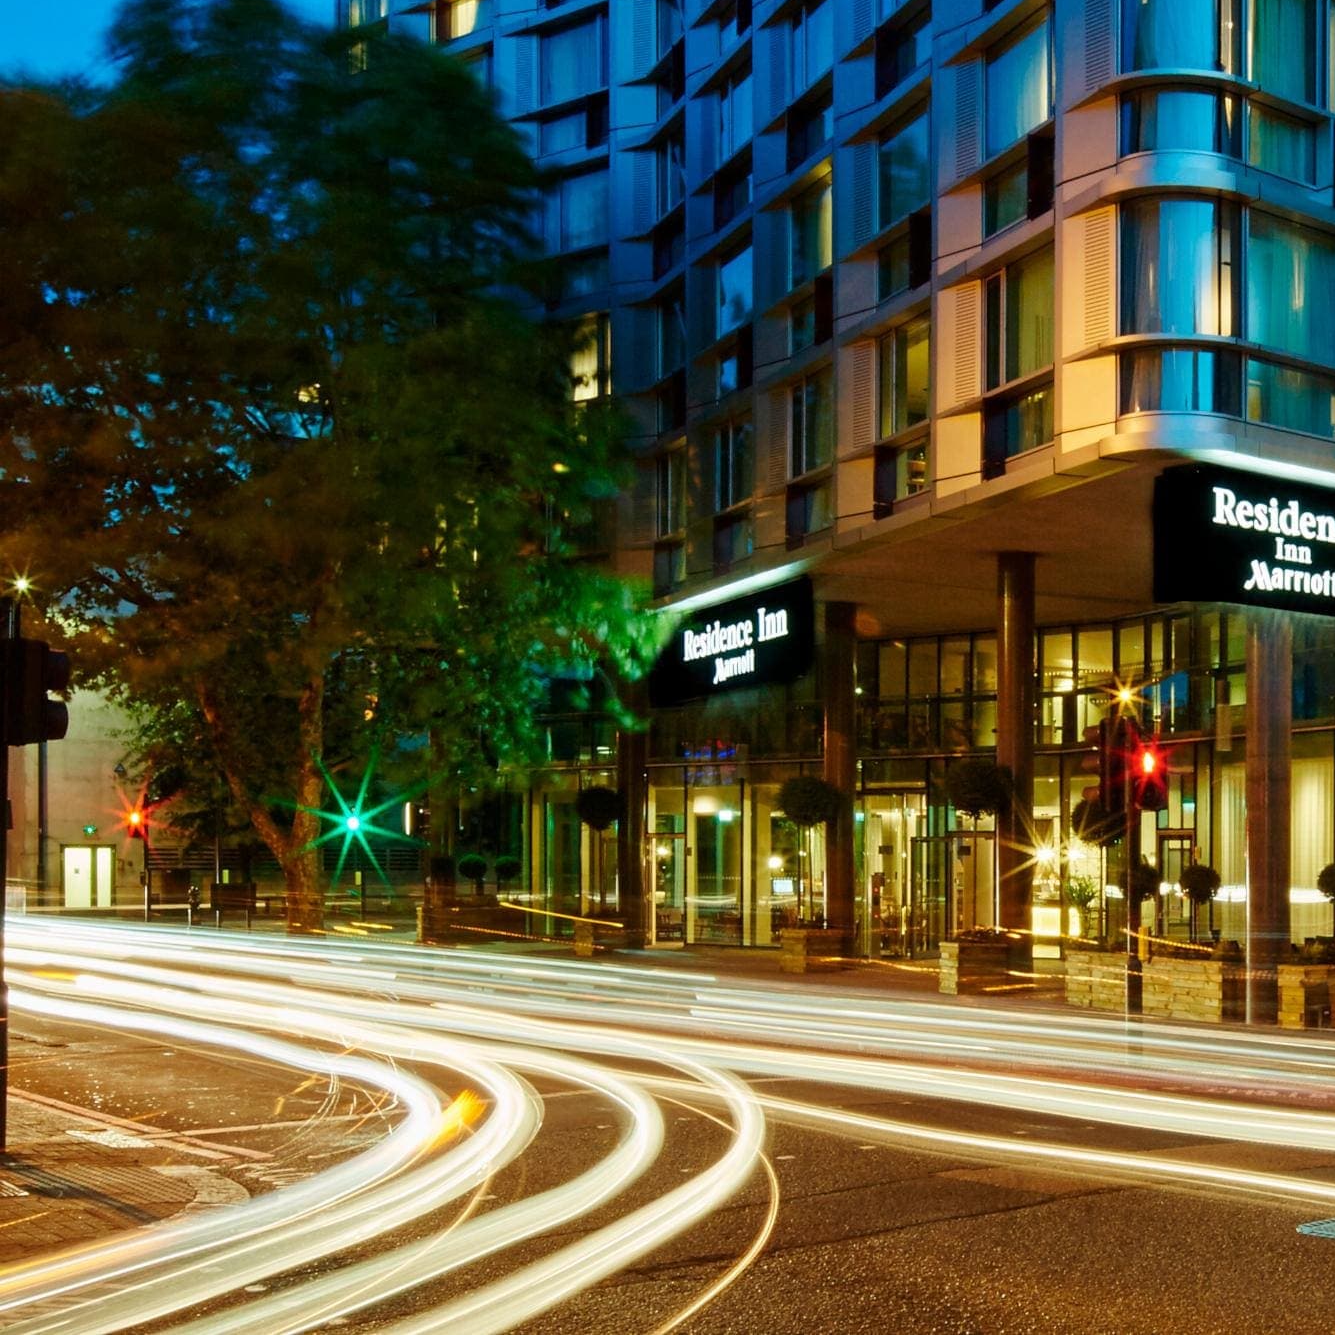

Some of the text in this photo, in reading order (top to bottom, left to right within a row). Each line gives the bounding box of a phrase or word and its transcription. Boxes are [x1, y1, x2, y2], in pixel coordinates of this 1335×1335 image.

[1275, 537, 1312, 564] Inn
[683, 607, 789, 661] Residence Inn
